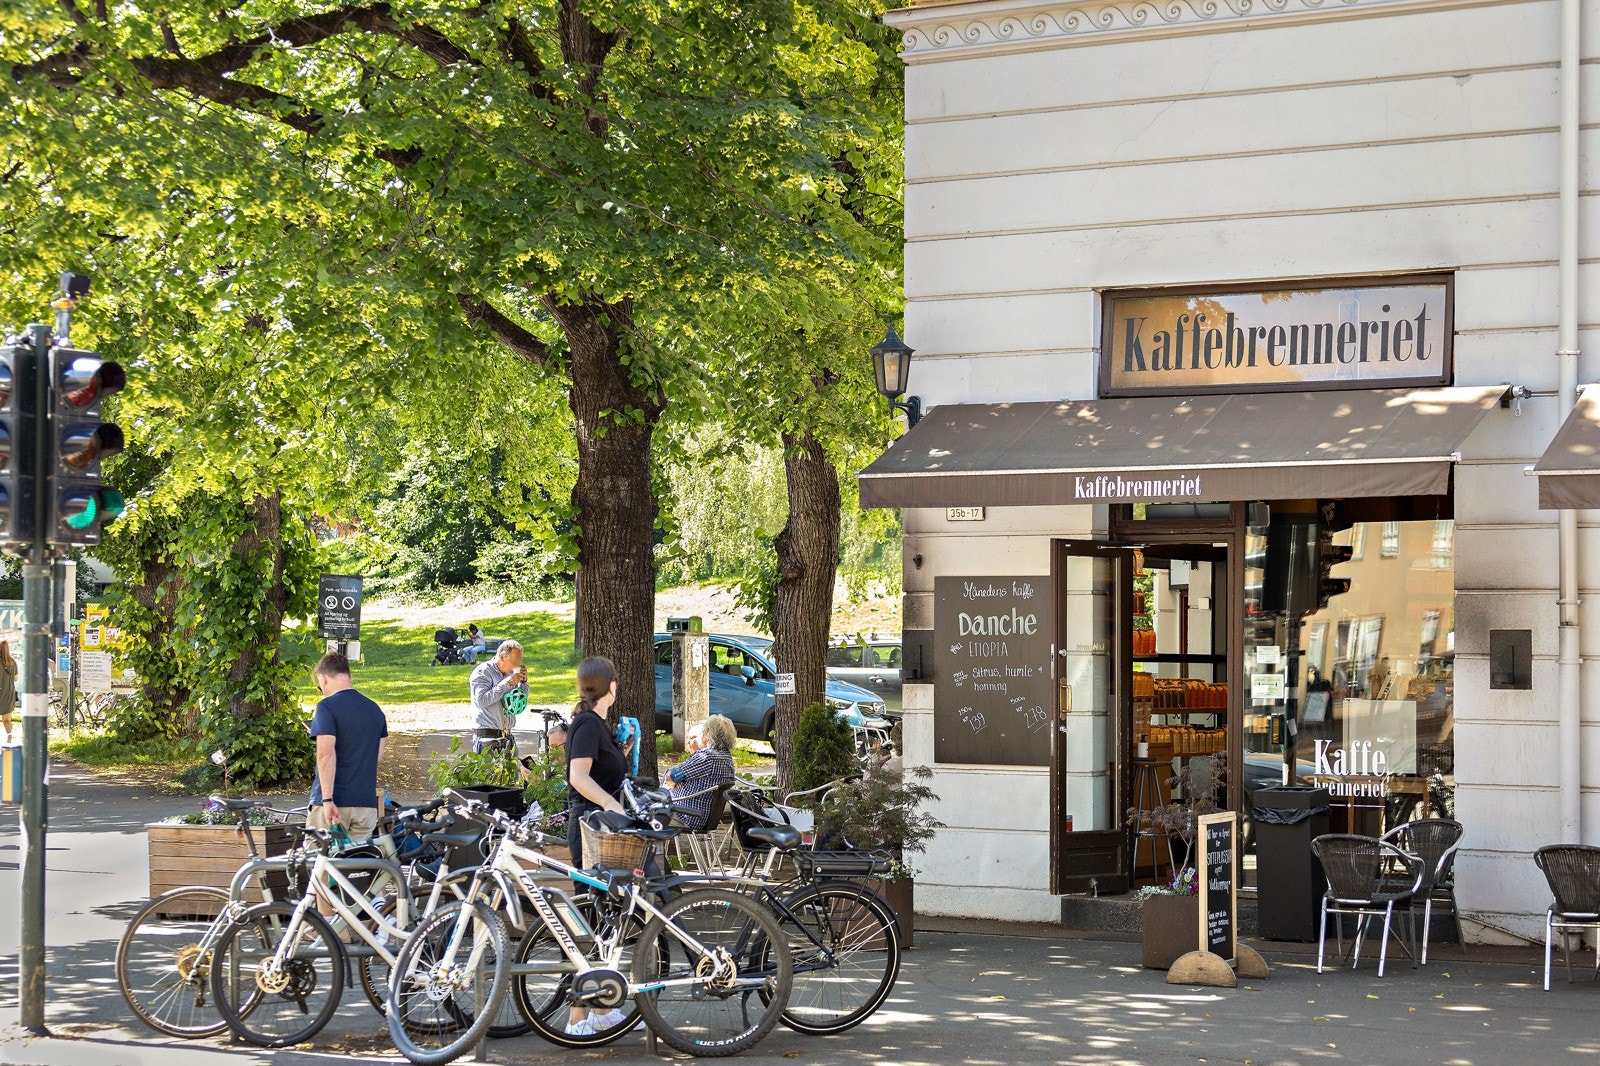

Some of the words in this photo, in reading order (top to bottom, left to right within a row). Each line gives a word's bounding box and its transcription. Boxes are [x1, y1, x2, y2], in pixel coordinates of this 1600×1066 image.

[1122, 302, 1432, 373] Kaffebrenneriet
[1074, 474, 1202, 499] Kaffebrenneriet
[958, 606, 1037, 636] Danche
[969, 641, 1008, 657] ETIOPIA
[1313, 739, 1386, 777] Kaffe
